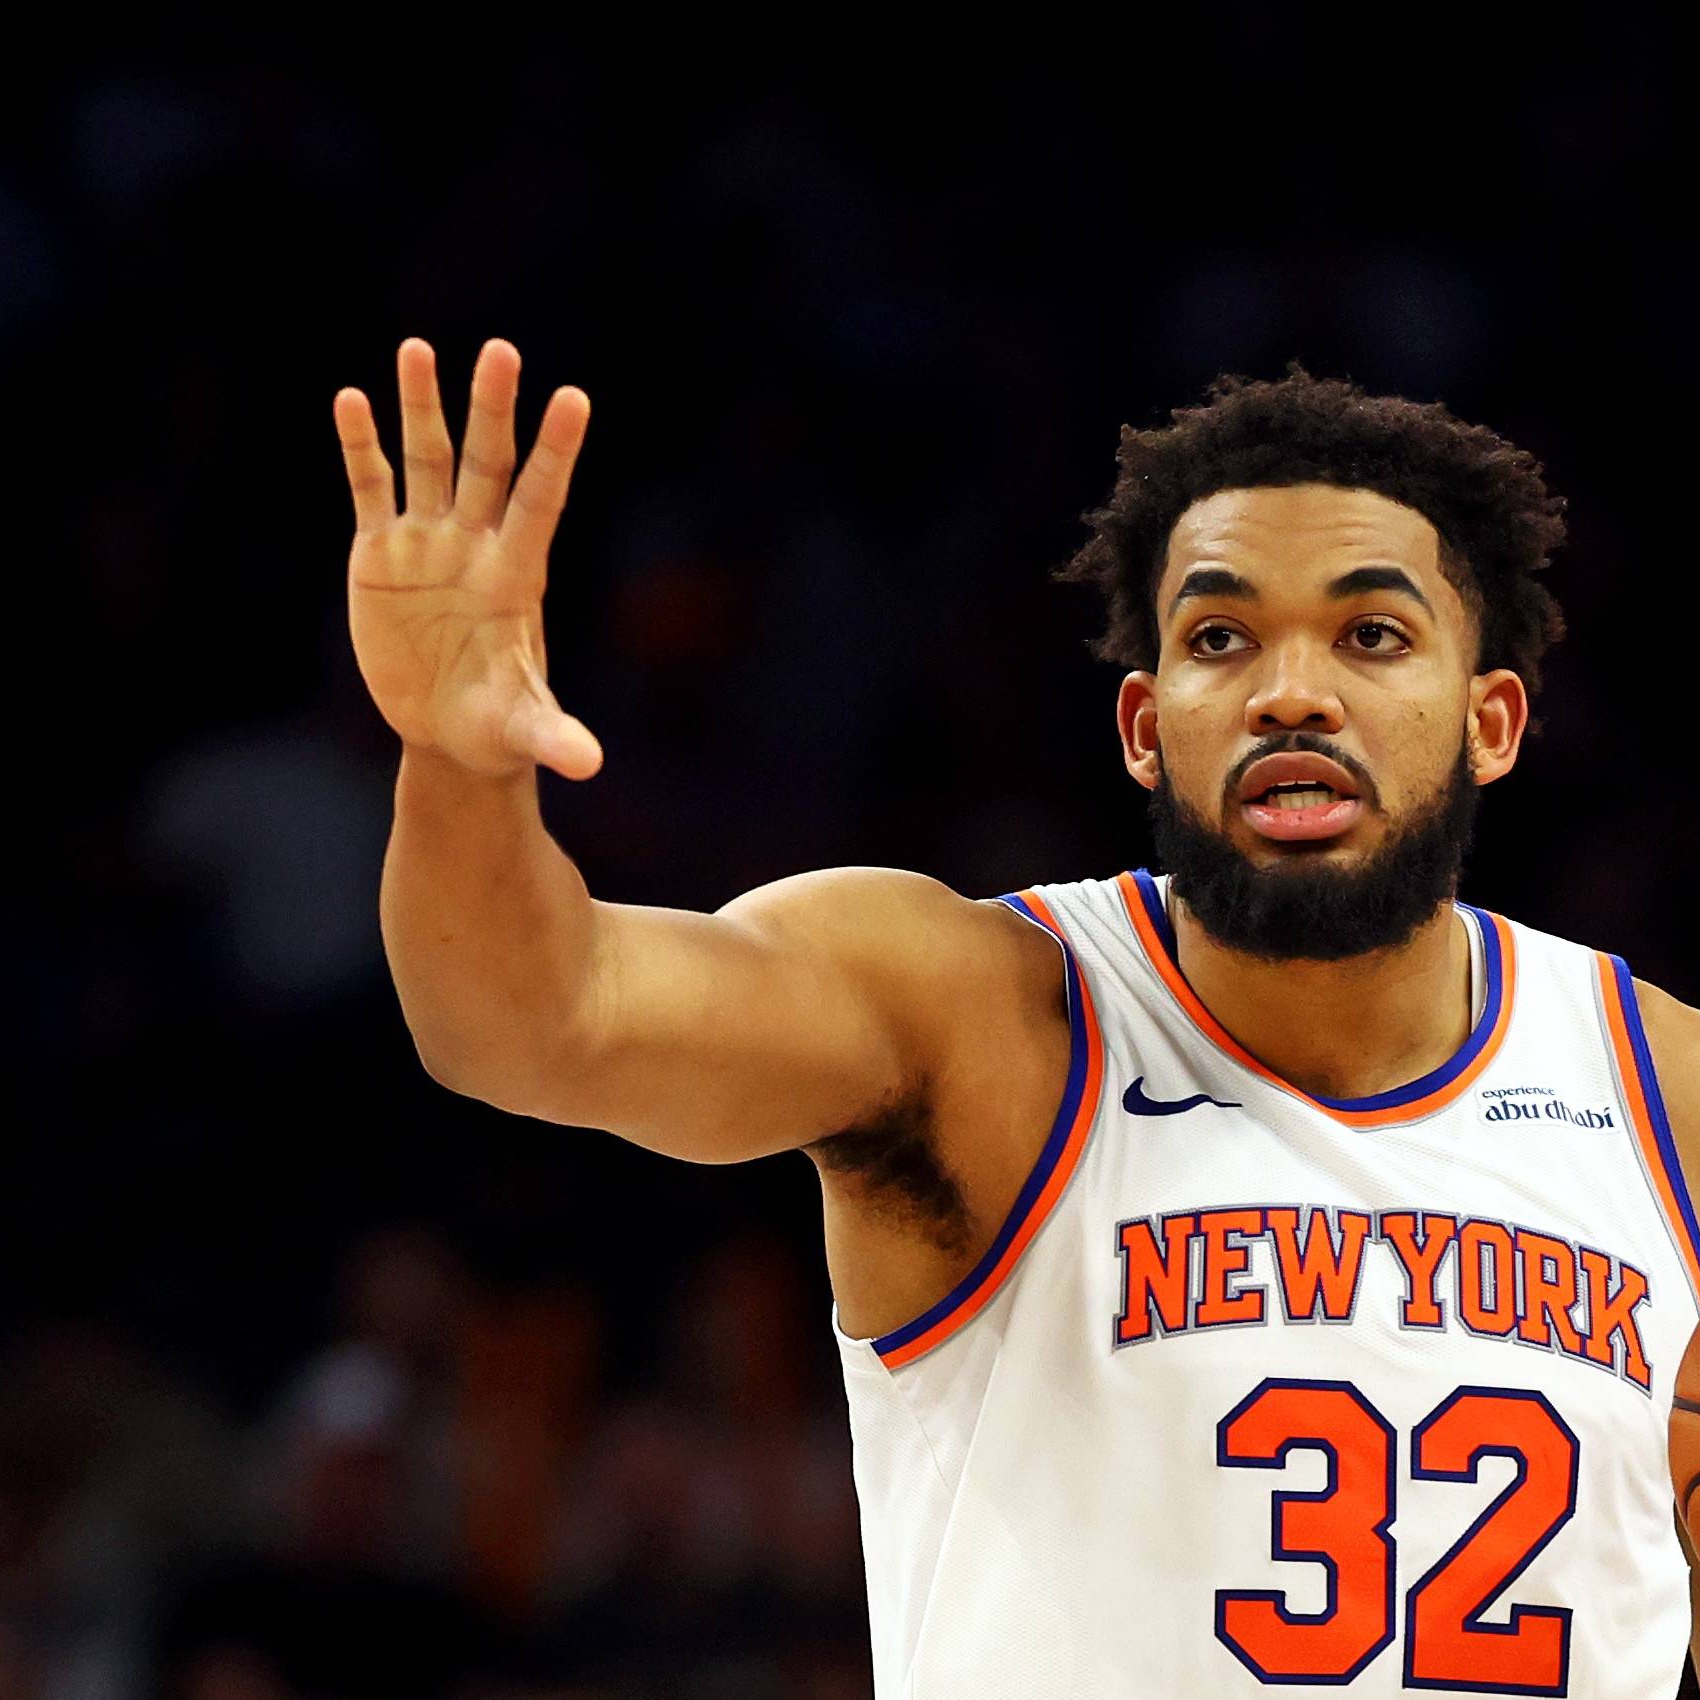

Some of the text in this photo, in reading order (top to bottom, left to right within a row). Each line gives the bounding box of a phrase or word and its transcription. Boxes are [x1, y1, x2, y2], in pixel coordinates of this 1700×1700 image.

[1482, 1085, 1555, 1098] experience
[1485, 1099, 1615, 1129] abu dhabi
[1112, 1203, 1653, 1399] NEW YORK
[1214, 1377, 1580, 1698] 32
